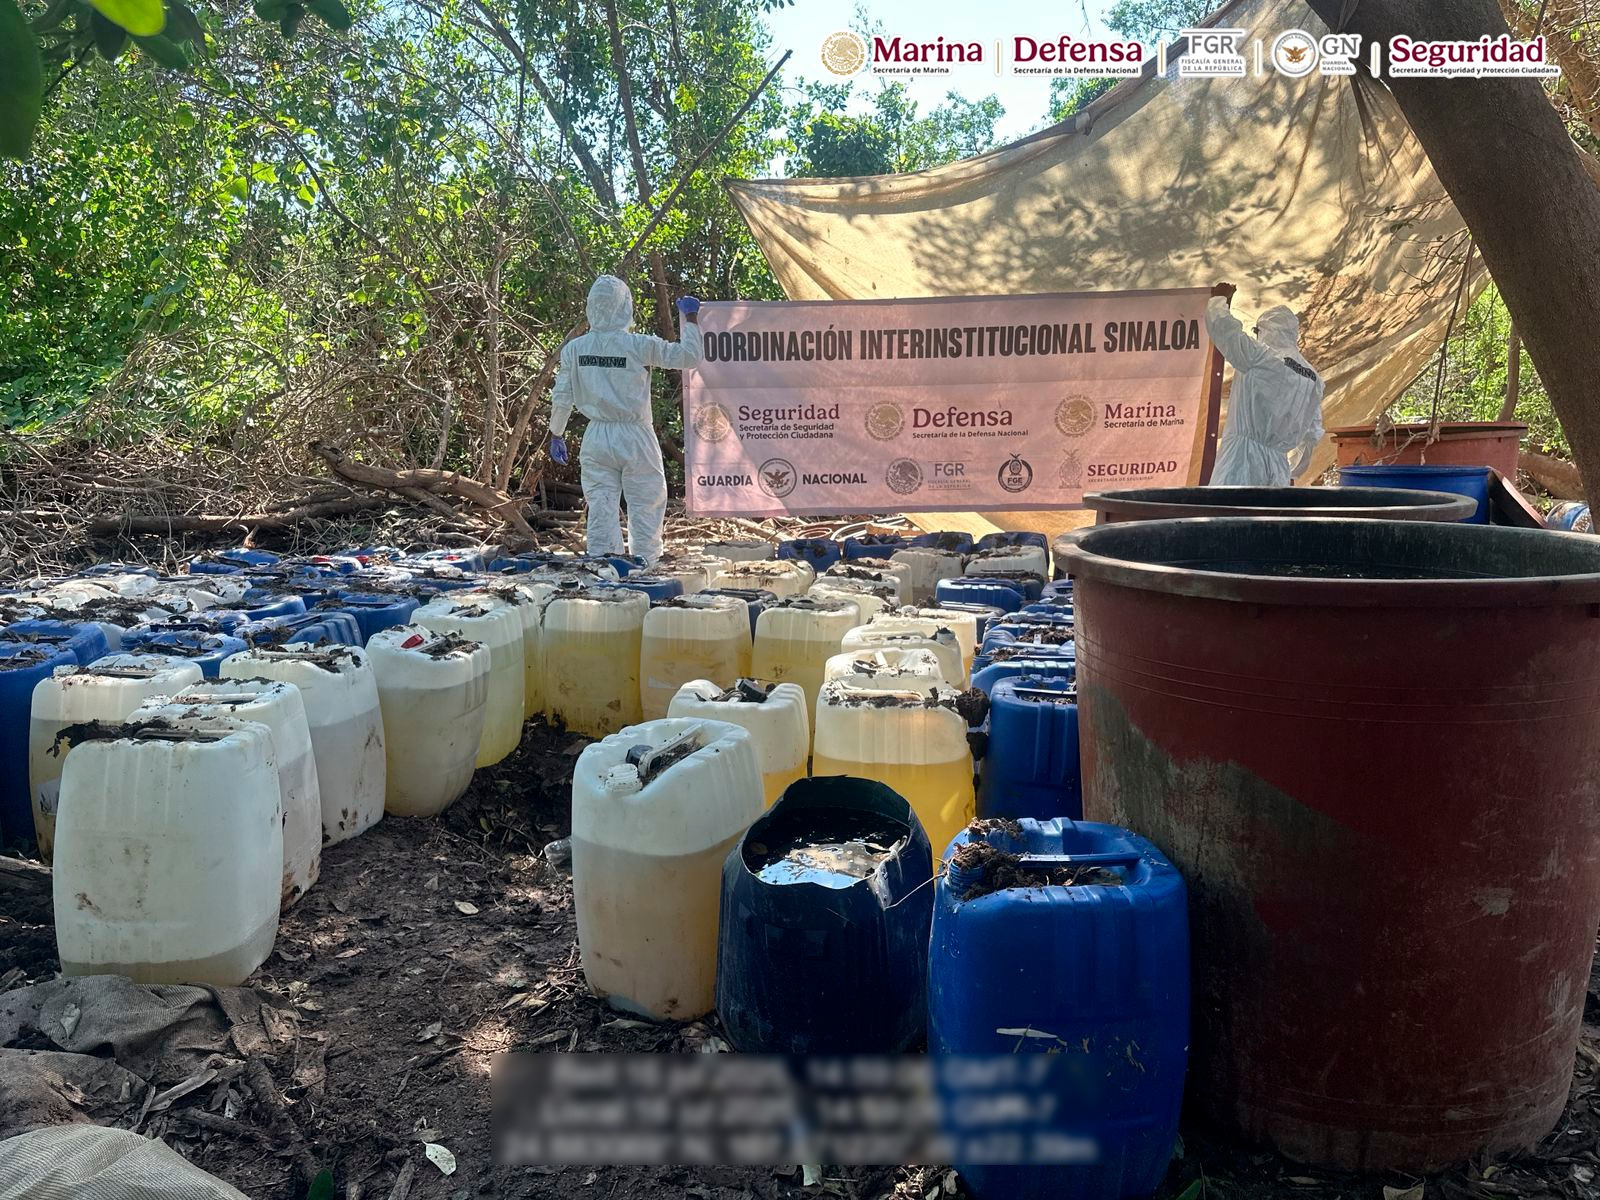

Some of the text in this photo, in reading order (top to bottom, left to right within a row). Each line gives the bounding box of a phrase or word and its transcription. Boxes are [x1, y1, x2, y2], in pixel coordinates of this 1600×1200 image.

[703, 319, 1200, 362] OORDINACIÓN INTERINSTITUCIONAL SINALOA
[738, 403, 840, 425] Seguridad
[912, 406, 1013, 428] Defensa
[1104, 401, 1176, 420] Marina
[739, 423, 834, 432] Secretaría de Seguridad
[1104, 418, 1185, 429] Secretaría de Marina
[746, 431, 789, 440] Protección
[790, 431, 834, 439] Ciudadana
[912, 431, 948, 439] Secretaría
[967, 430, 996, 438] Defensa
[997, 429, 1029, 437] Nacional
[934, 463, 965, 477] FGR
[1087, 460, 1178, 477] SEGURIDAD
[697, 473, 868, 487] GUARDIA NACIONAL
